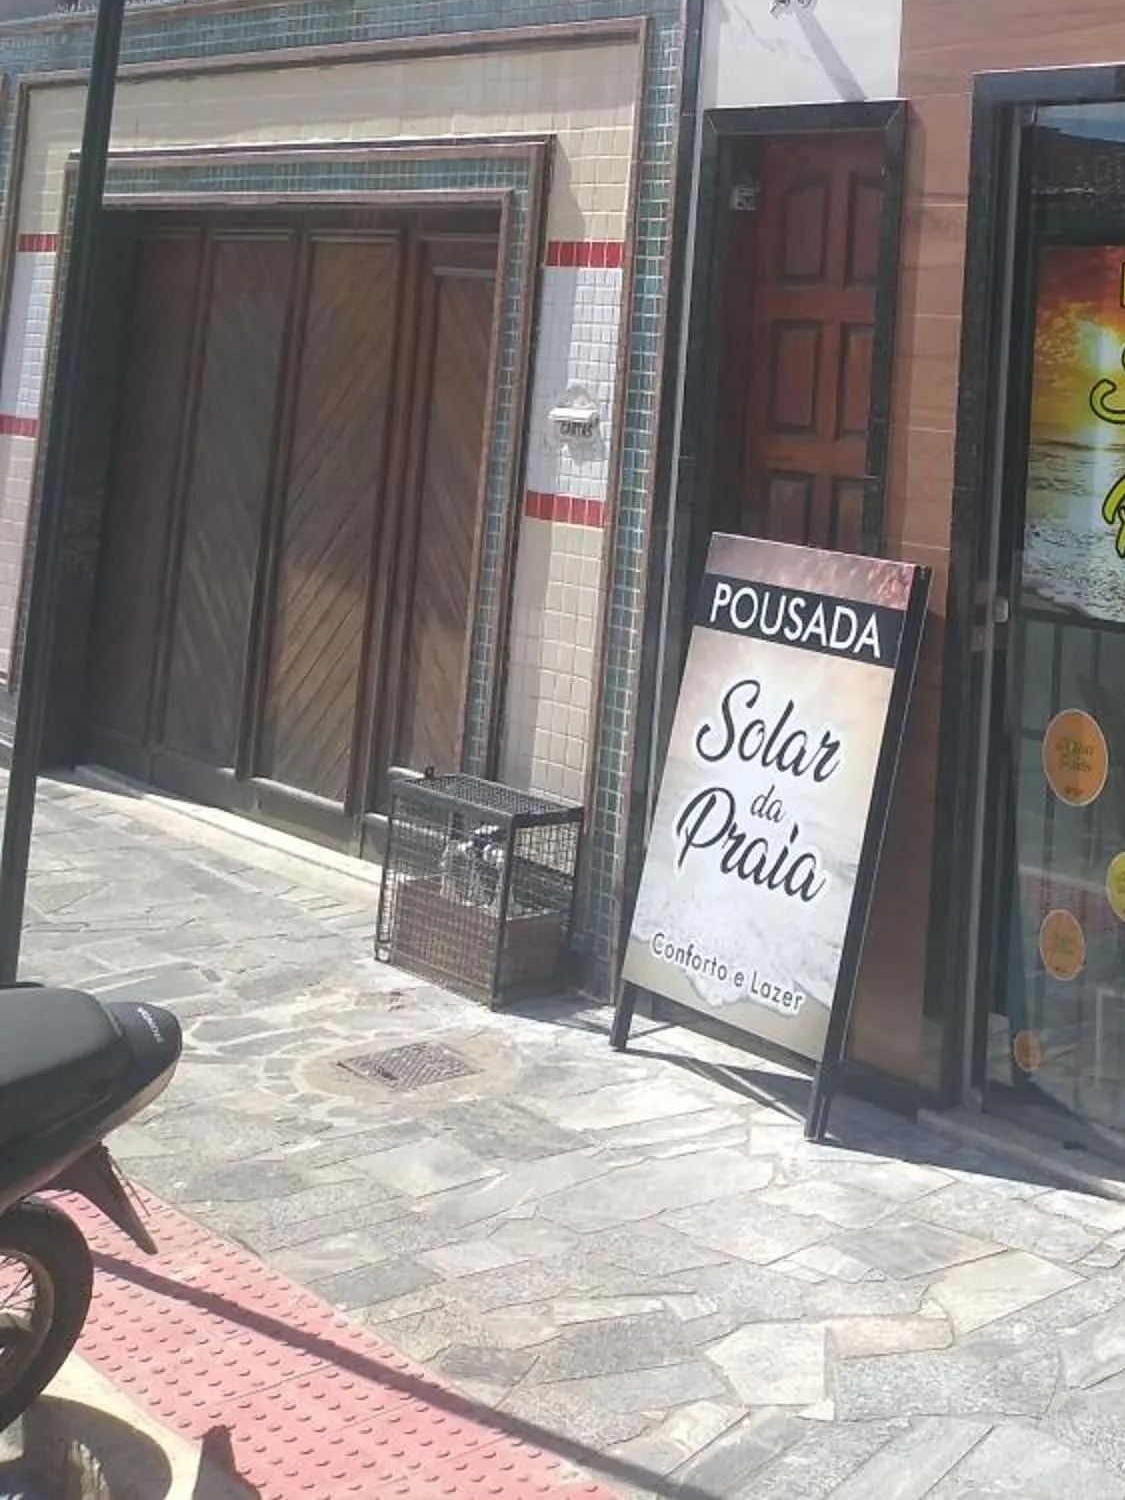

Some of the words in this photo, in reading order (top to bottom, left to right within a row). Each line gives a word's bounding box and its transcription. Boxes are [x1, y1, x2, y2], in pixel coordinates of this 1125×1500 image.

[709, 583, 881, 657] POUSADA
[695, 678, 841, 783] Solar
[675, 785, 824, 902] Praia
[750, 784, 784, 824] da
[651, 931, 728, 982] Conforto
[733, 969, 745, 987] e
[751, 977, 803, 1012] Lazer
